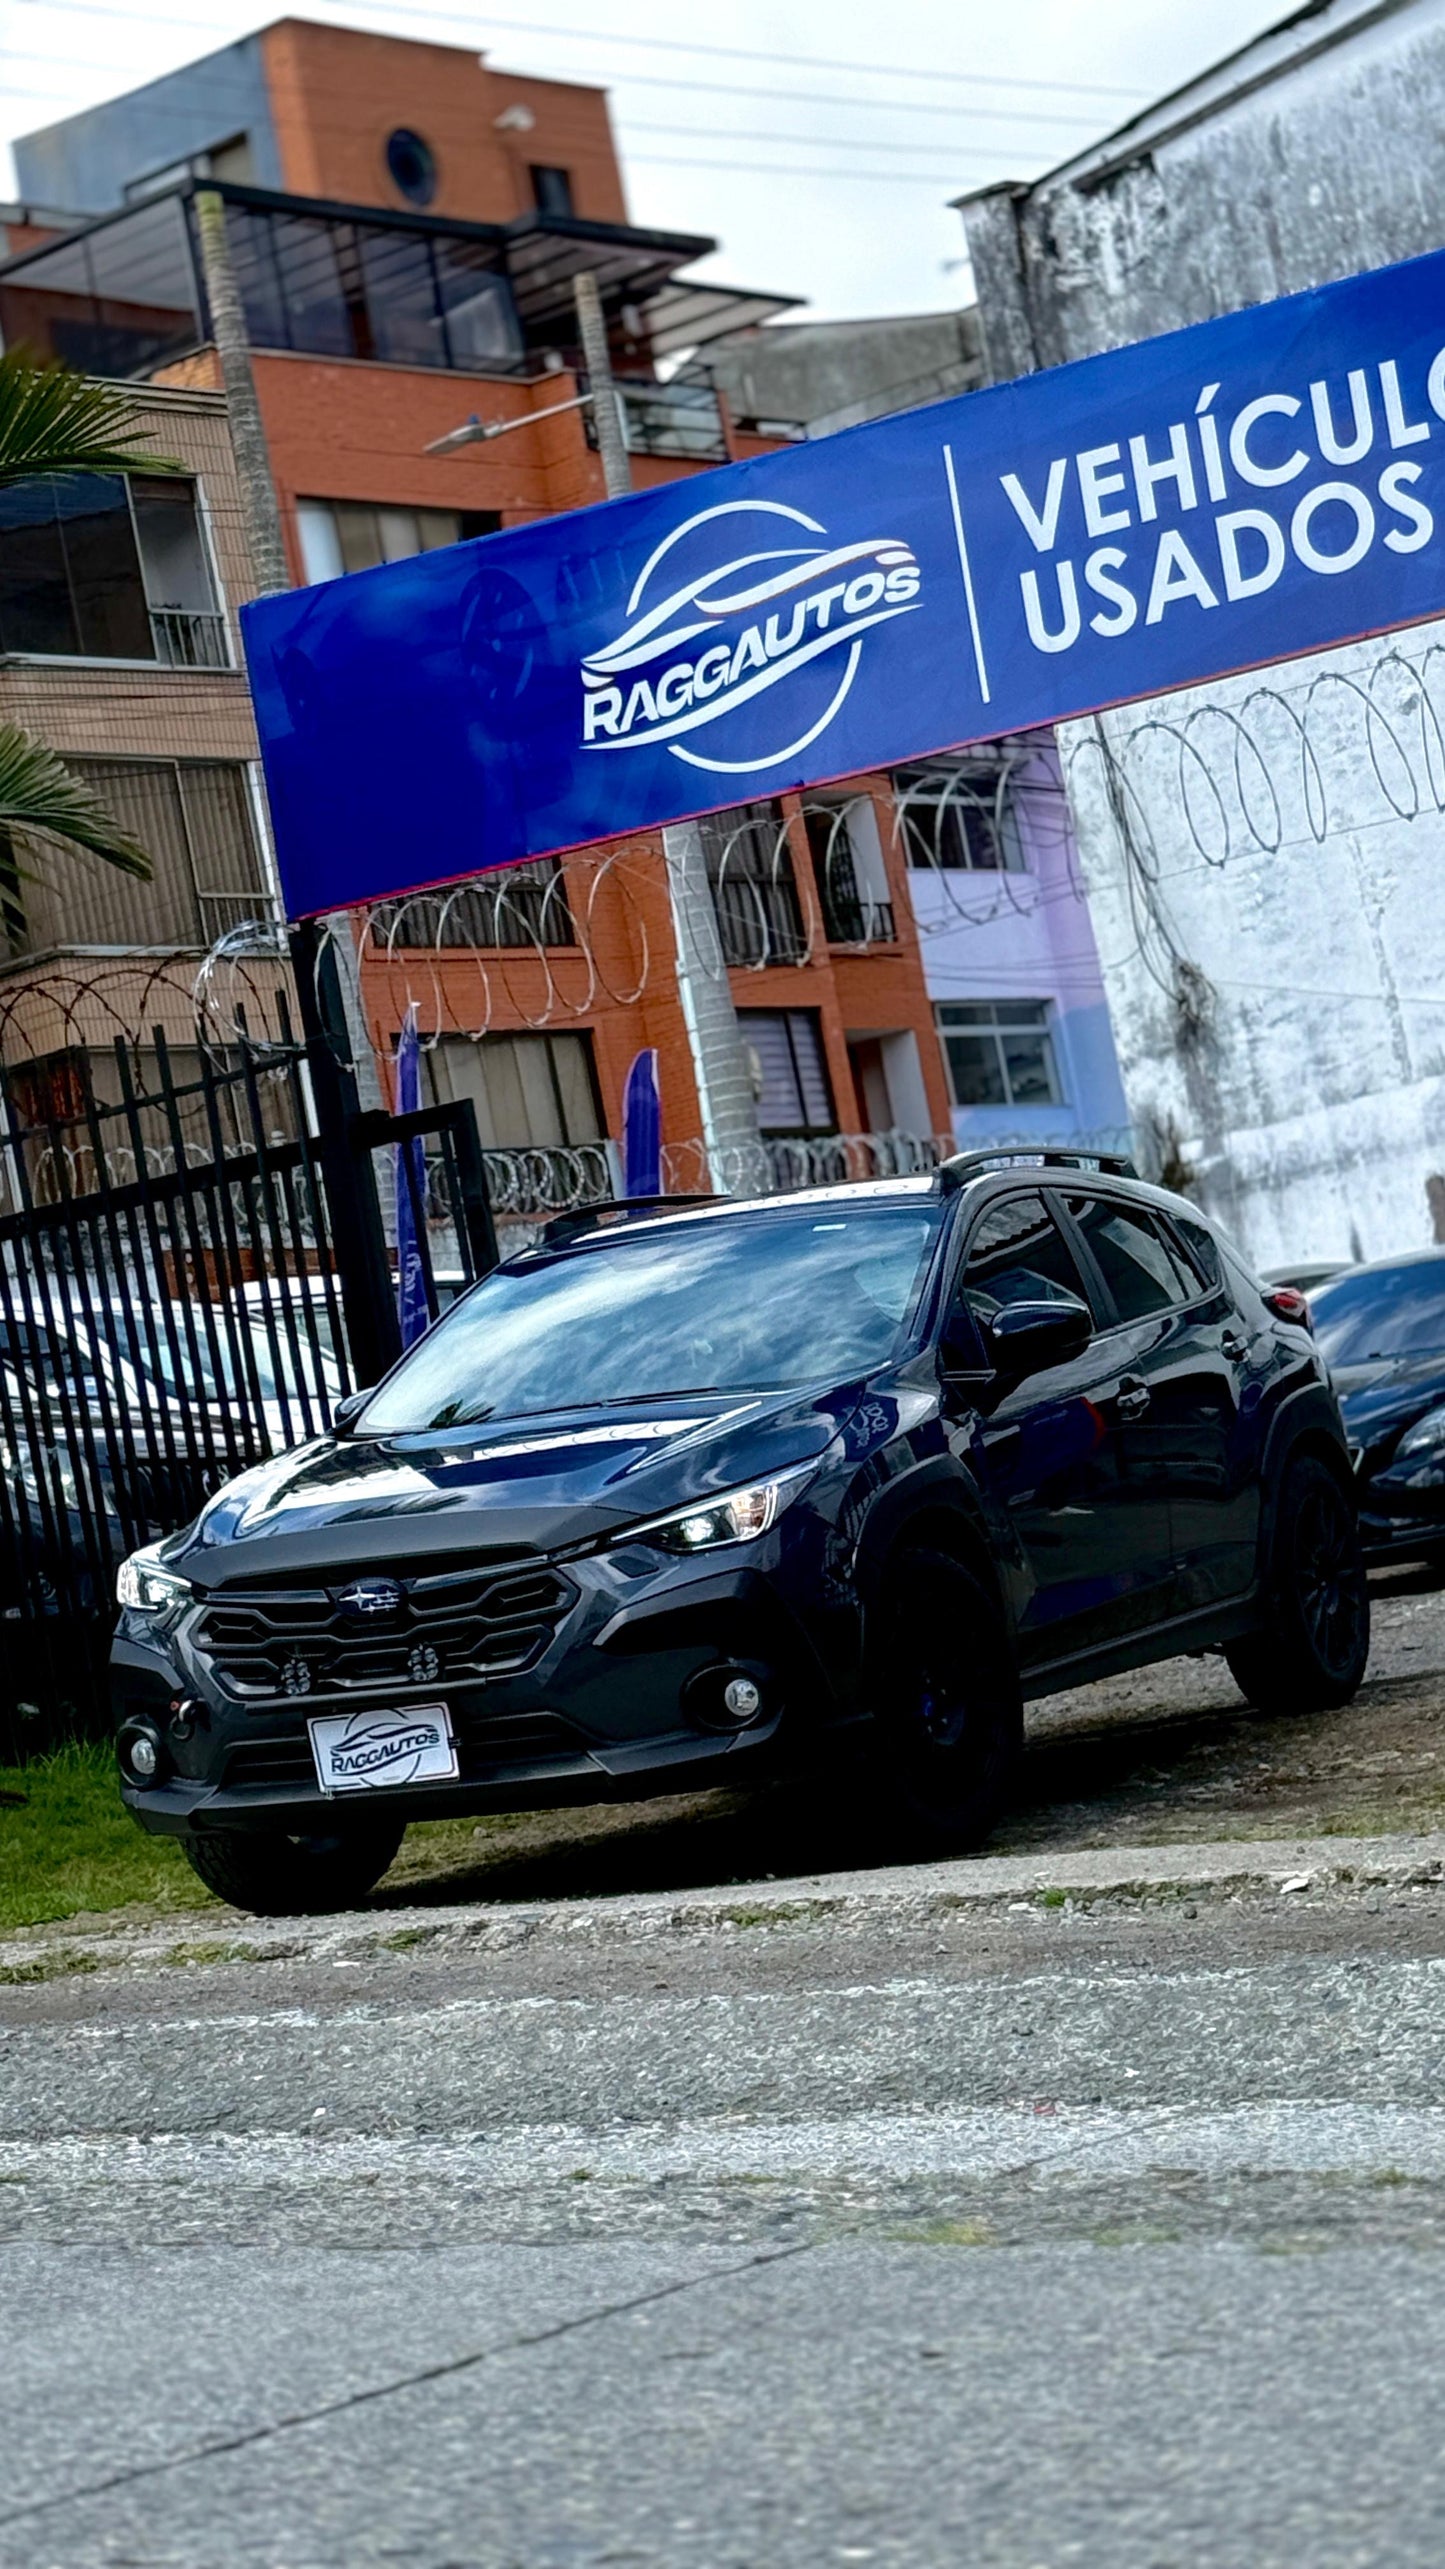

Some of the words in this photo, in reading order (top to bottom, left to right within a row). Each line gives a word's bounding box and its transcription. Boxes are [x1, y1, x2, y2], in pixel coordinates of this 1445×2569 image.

[999, 345, 1445, 553] VEHÍCUL
[1020, 461, 1434, 653] USADOS
[583, 566, 921, 741] RAGGAUTOS
[331, 1732, 440, 1773] RAGGAUTOS
